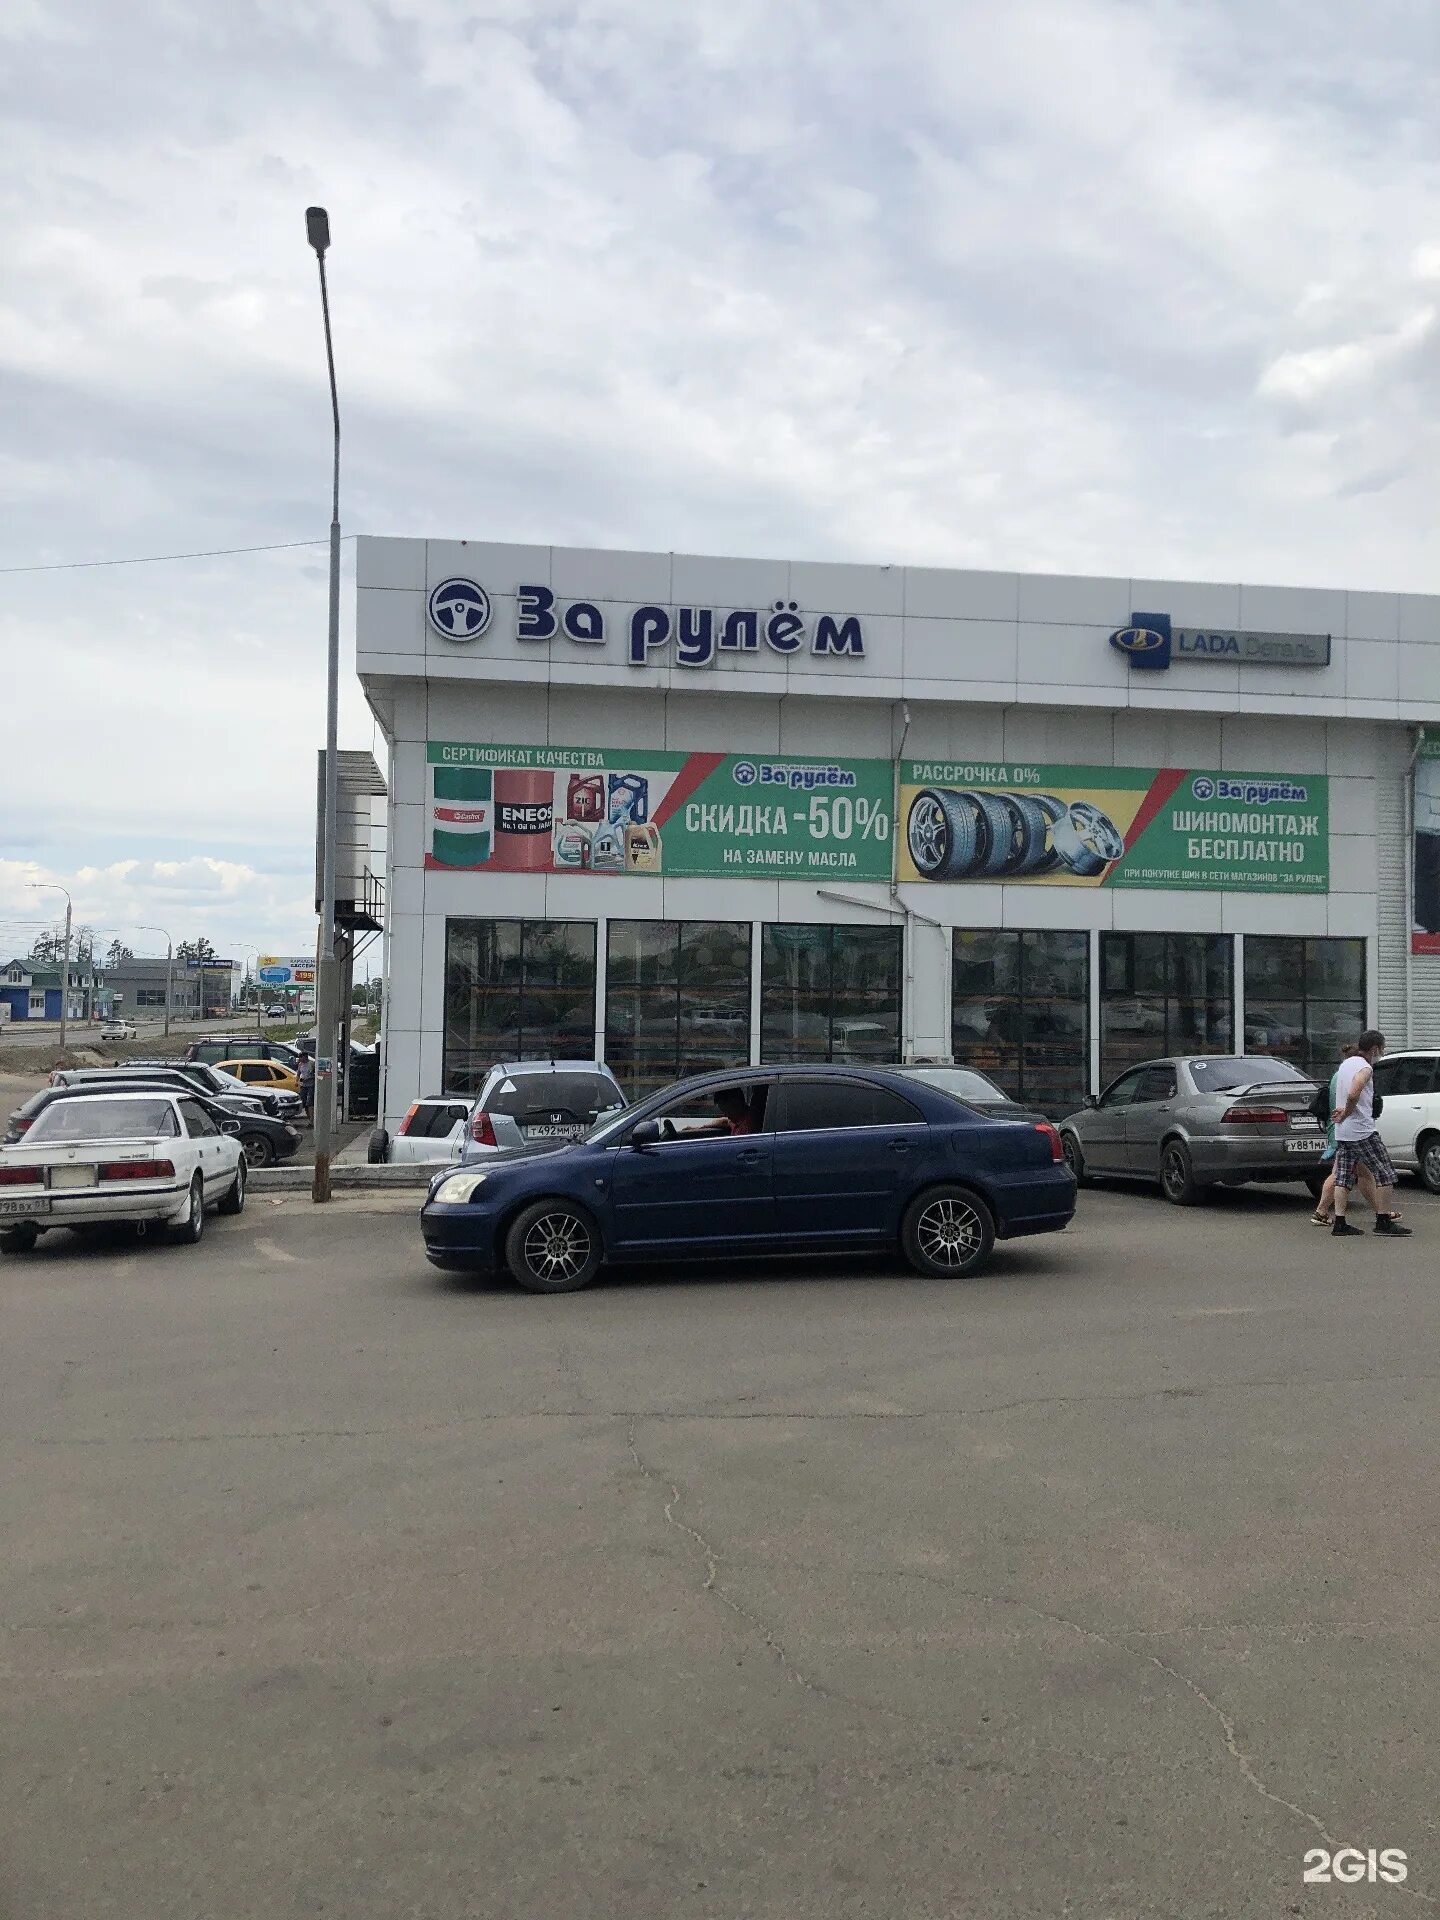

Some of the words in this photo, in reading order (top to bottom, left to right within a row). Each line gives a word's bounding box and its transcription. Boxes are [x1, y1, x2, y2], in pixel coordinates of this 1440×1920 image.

[517, 584, 606, 644] За
[628, 601, 866, 667] рулём
[1180, 633, 1239, 653] LADA
[442, 746, 533, 763] СЕРТИФИКАТ
[536, 751, 605, 766] КАЧЕСТВА
[760, 765, 788, 783] За
[789, 765, 856, 789] рулём
[912, 764, 1008, 782] РАССРОЧКА
[1013, 767, 1040, 784] 0%
[576, 797, 590, 805] ZIC
[1218, 781, 1243, 798] За
[1245, 781, 1307, 804] рулём
[502, 806, 552, 822] ENEOS
[685, 803, 788, 836] СКИДКА
[793, 796, 889, 841] -50%
[1172, 810, 1319, 836] ШИНОМОНТАЖ
[517, 822, 528, 830] Oil
[529, 822, 537, 830] in
[723, 849, 742, 864] НА
[746, 849, 803, 865] ЗАМЕНУ
[808, 851, 857, 867] МАСЛА
[1188, 838, 1304, 862] БЕСПЛАТНО
[1124, 868, 1140, 878] ПРИ
[1142, 869, 1180, 879] ПОКУПКЕ
[1182, 870, 1200, 880] ШИН
[1201, 871, 1208, 880] В
[1209, 871, 1230, 880] СЕТИ
[1231, 872, 1278, 882] МАГАЗИНОВ
